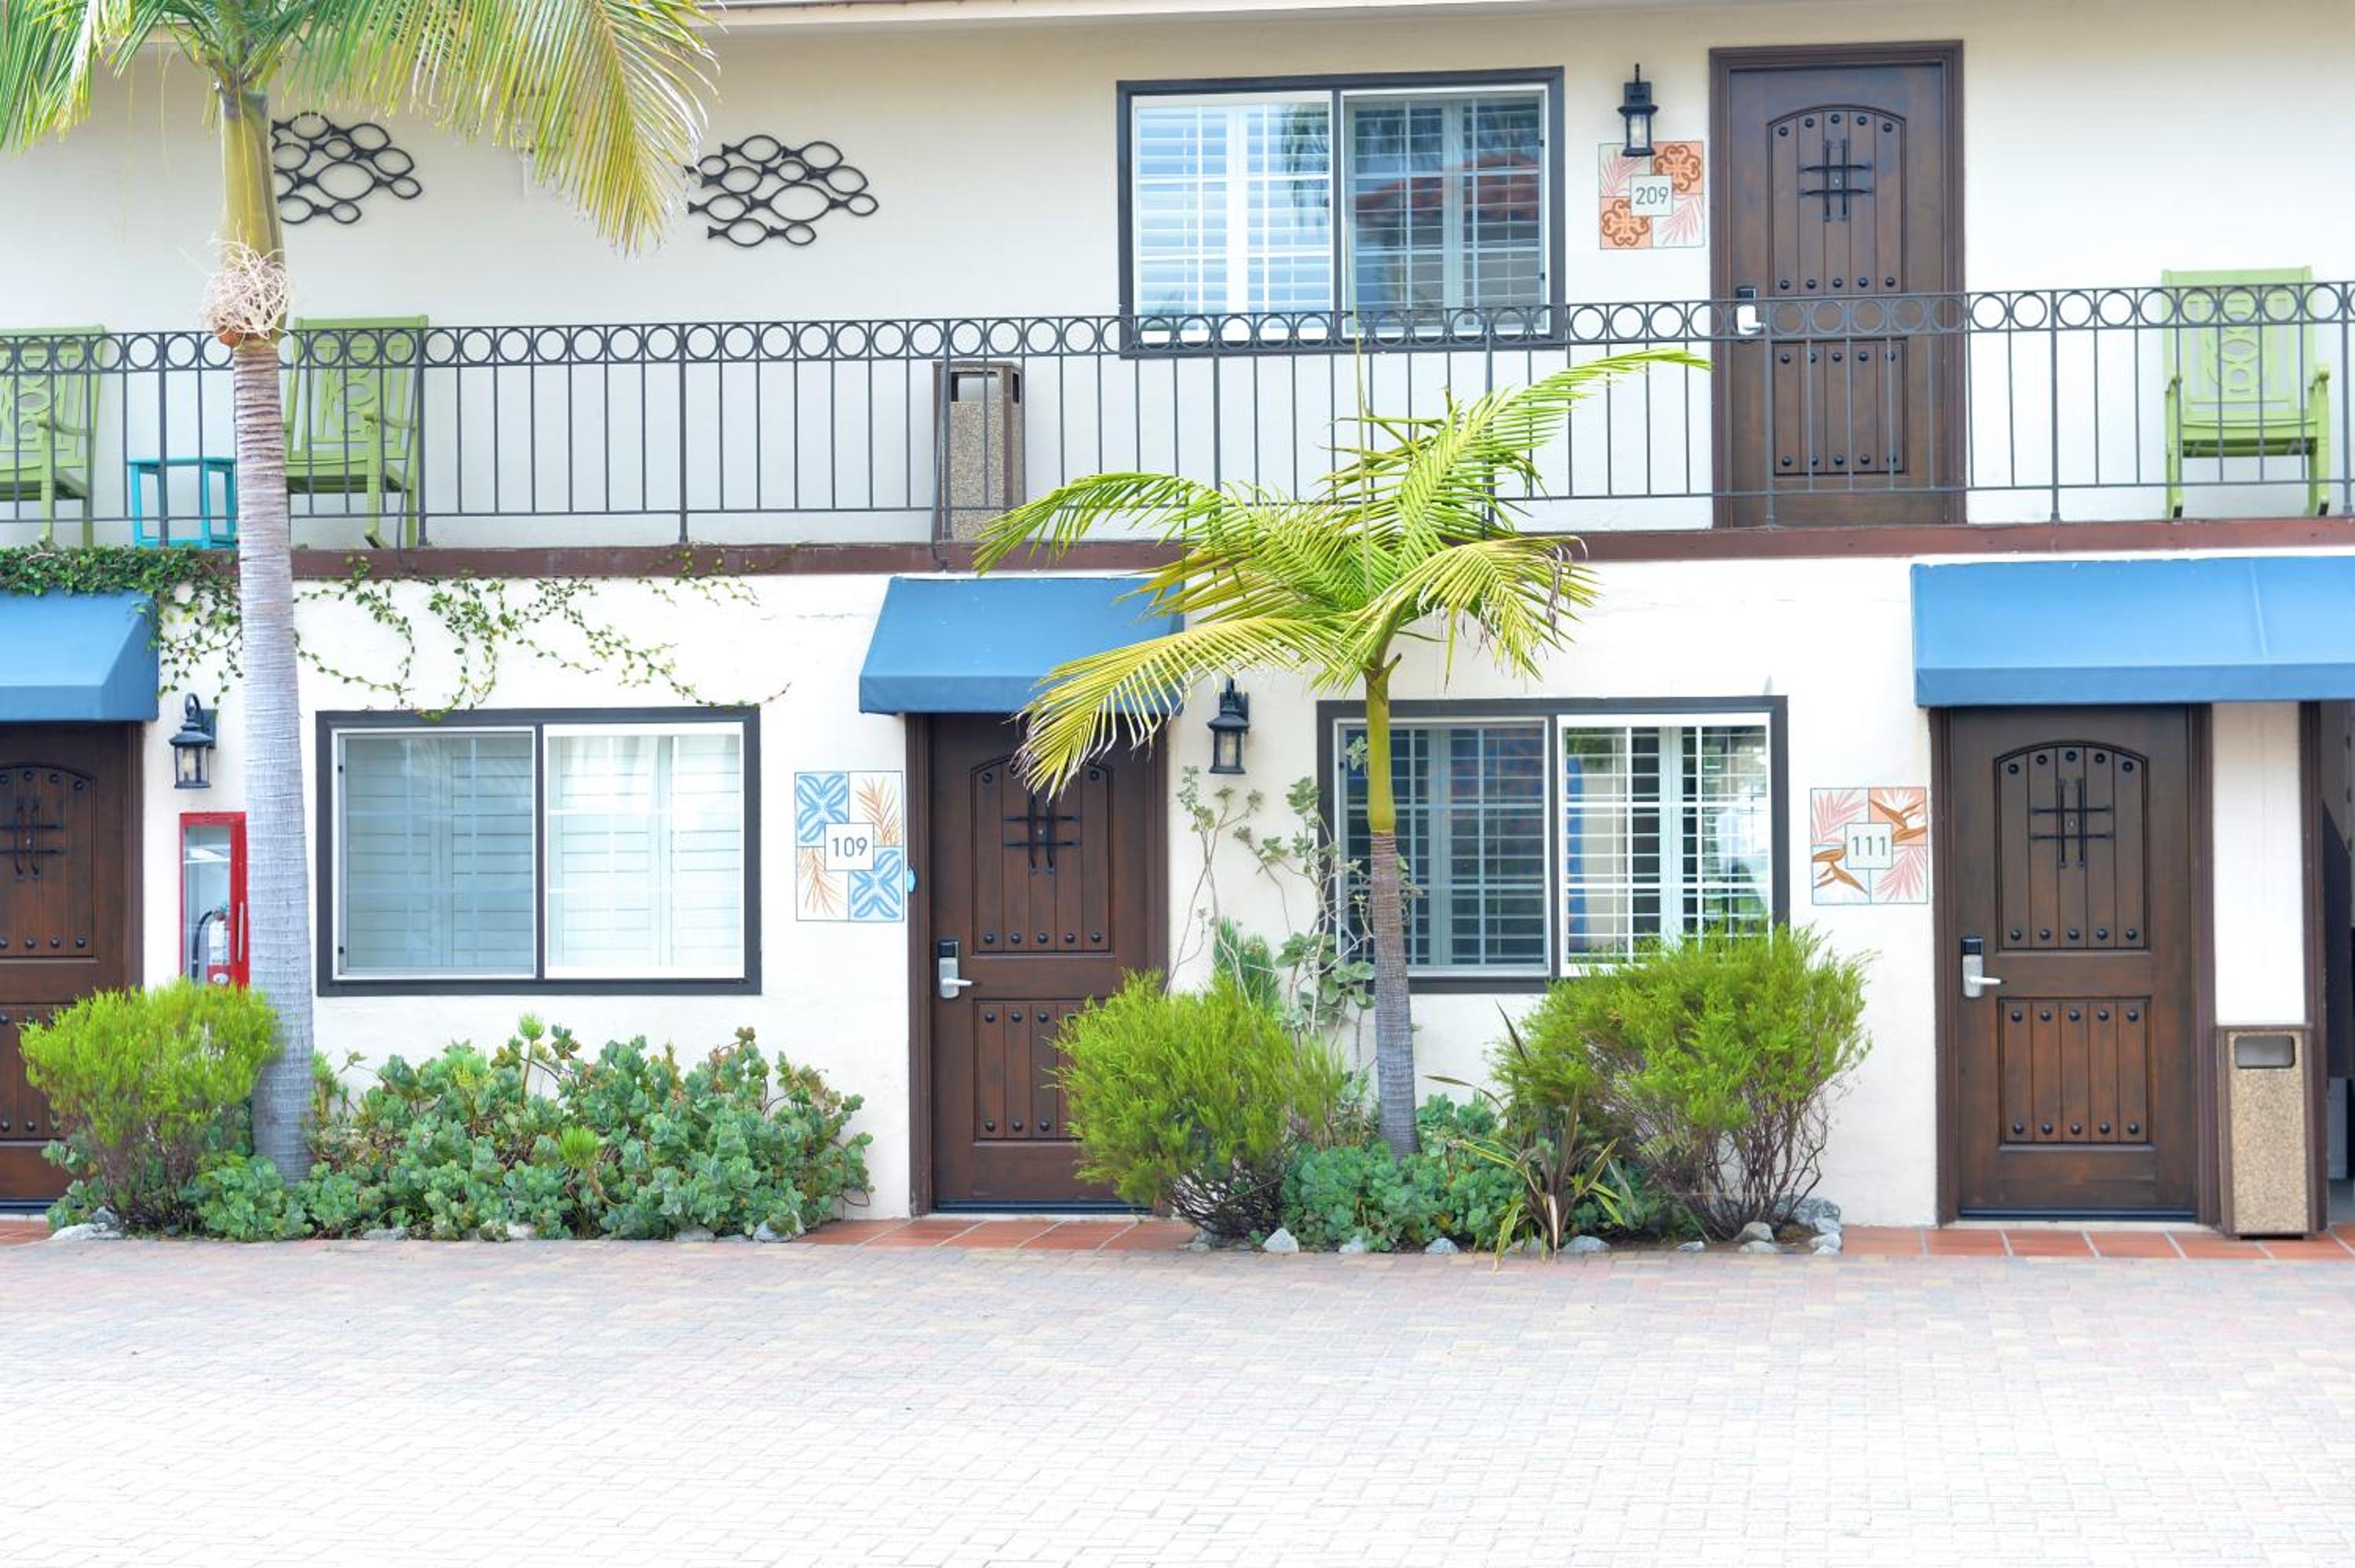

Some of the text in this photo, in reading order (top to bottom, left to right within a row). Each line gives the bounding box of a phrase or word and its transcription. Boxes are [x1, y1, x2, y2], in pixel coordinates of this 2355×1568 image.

[1635, 186, 1668, 204] 209
[832, 837, 867, 857] 109
[1852, 836, 1886, 856] 111
